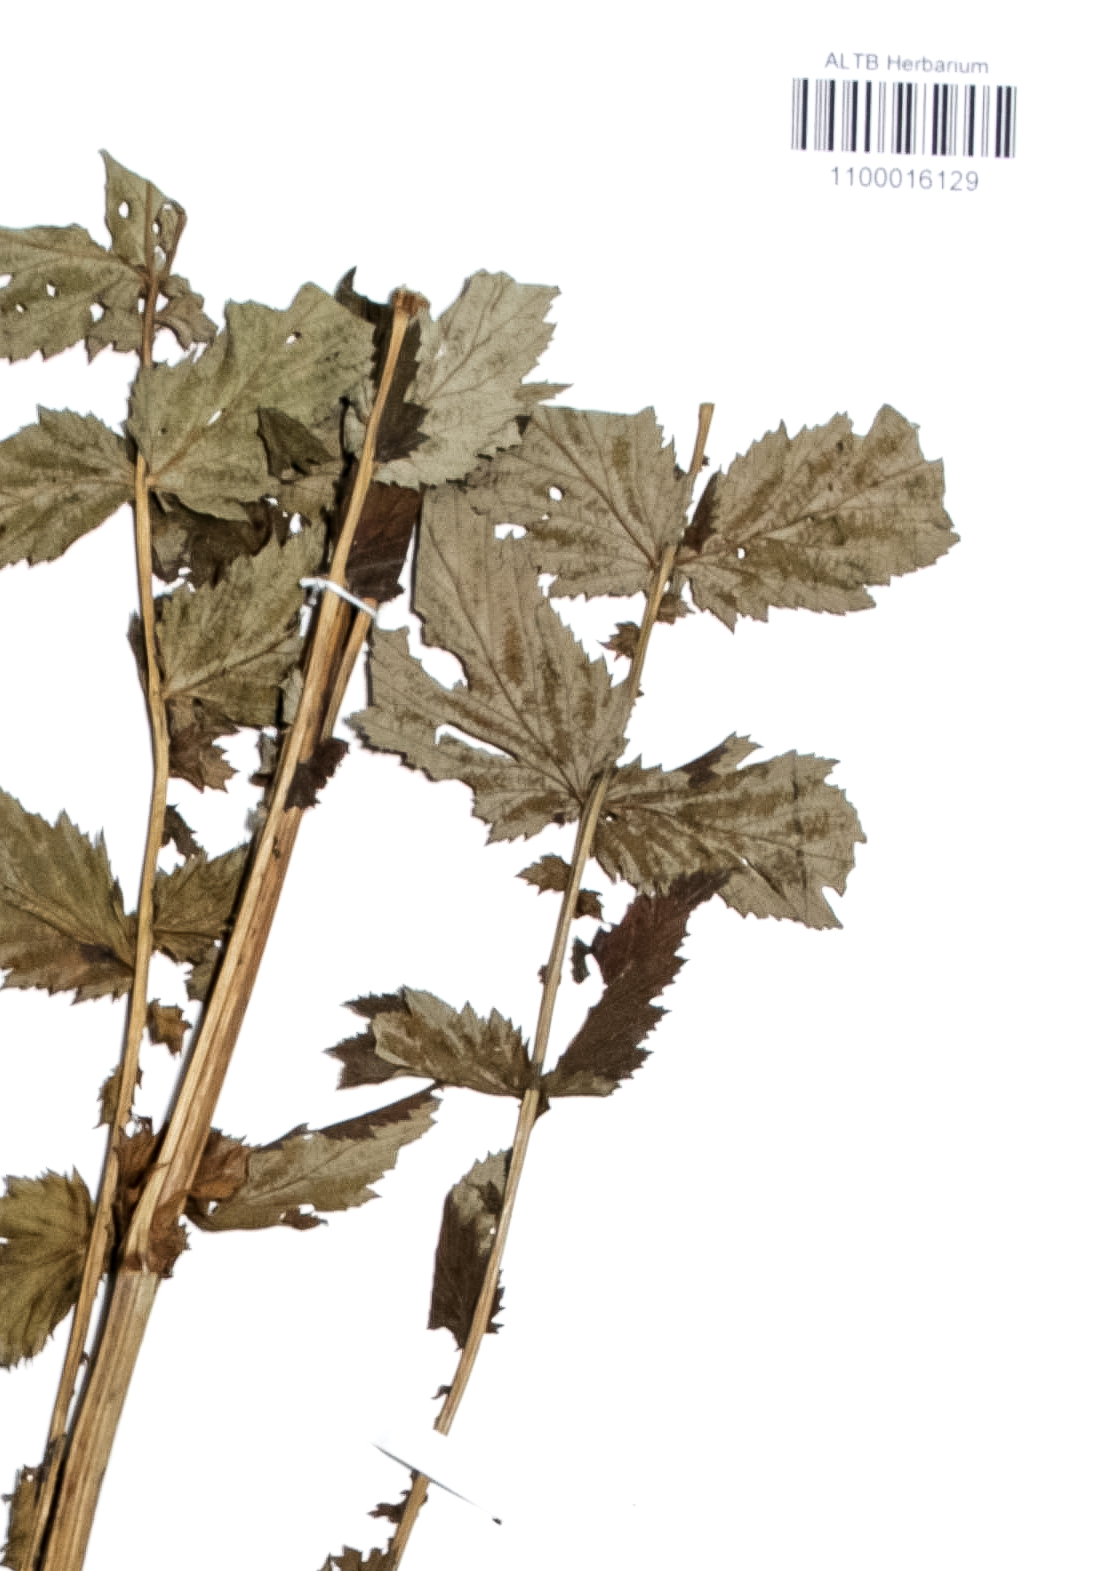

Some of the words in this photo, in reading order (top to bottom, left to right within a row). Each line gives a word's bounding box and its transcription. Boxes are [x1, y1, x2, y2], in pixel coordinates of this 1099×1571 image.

[824, 51, 879, 71] ALTB
[886, 54, 989, 74] Herbarium
[831, 166, 979, 192] 1100016129
